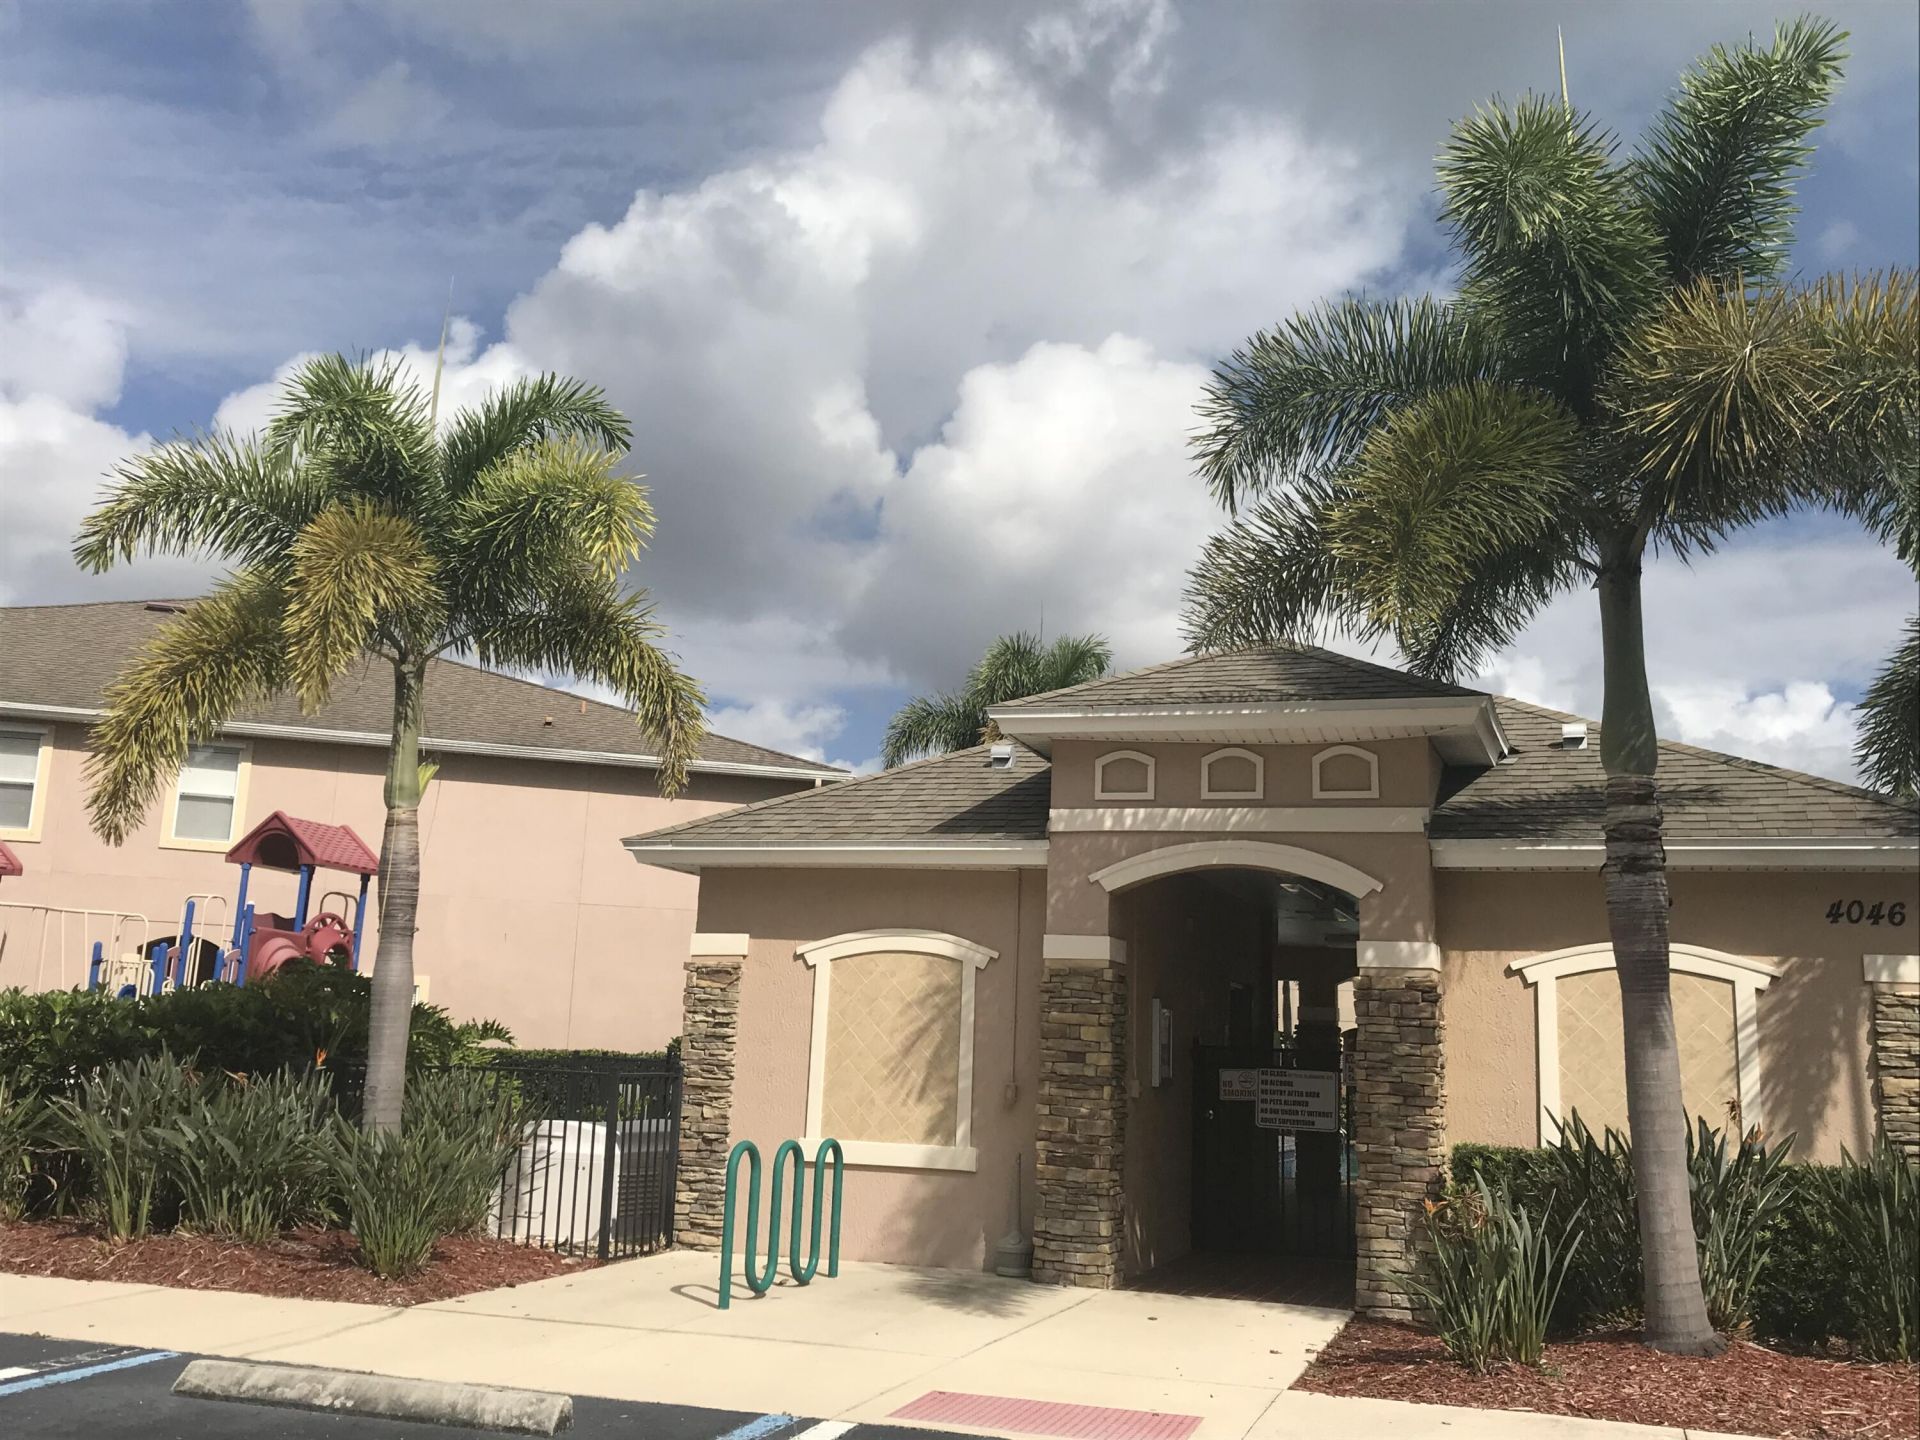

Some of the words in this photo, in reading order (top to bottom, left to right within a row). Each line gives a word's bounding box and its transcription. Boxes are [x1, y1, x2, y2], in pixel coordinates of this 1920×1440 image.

[1825, 899, 1906, 927] 4046
[1222, 1080, 1233, 1088] NO
[1222, 1088, 1256, 1097] SMOKING
[1278, 1118, 1315, 1126] SUPERVISION
